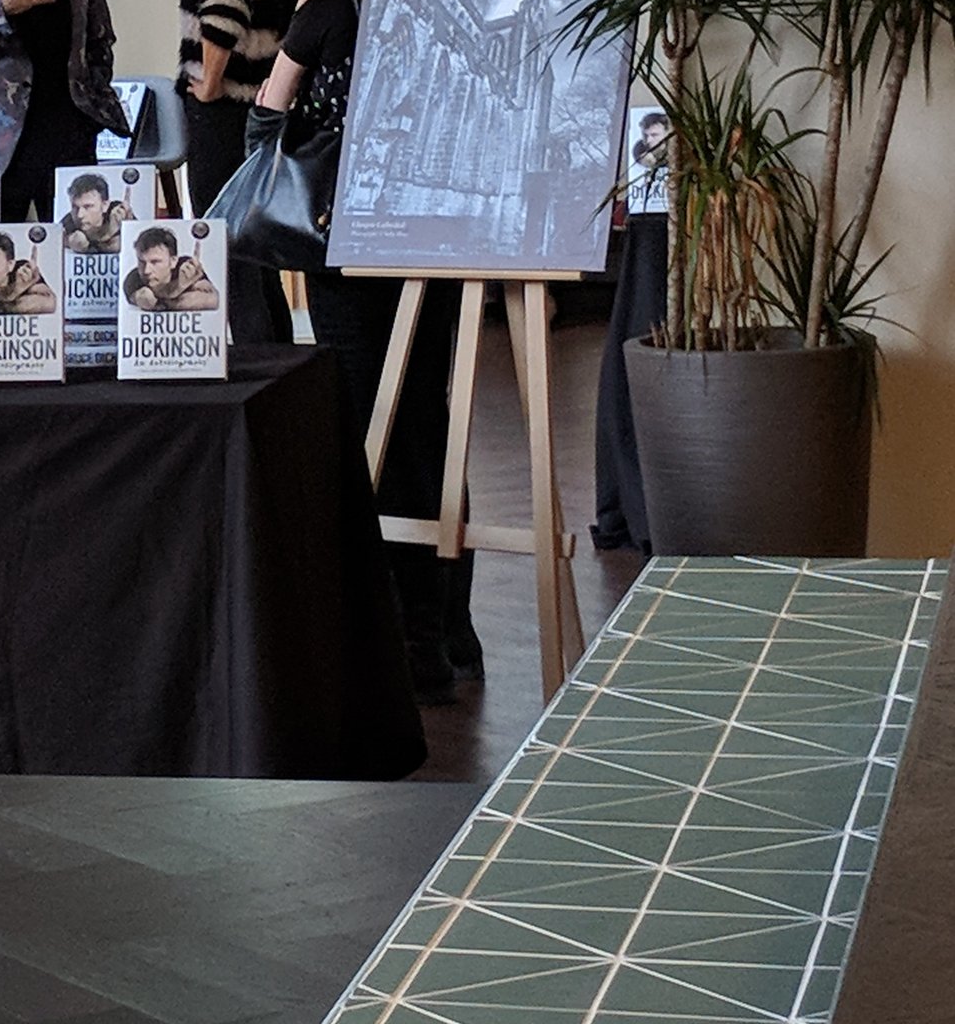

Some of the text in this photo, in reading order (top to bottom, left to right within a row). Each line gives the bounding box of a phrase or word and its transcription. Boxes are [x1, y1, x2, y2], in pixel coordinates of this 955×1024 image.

[74, 255, 119, 276] BRUC
[140, 313, 202, 335] BRUCE
[122, 336, 220, 358] DICKINSON
